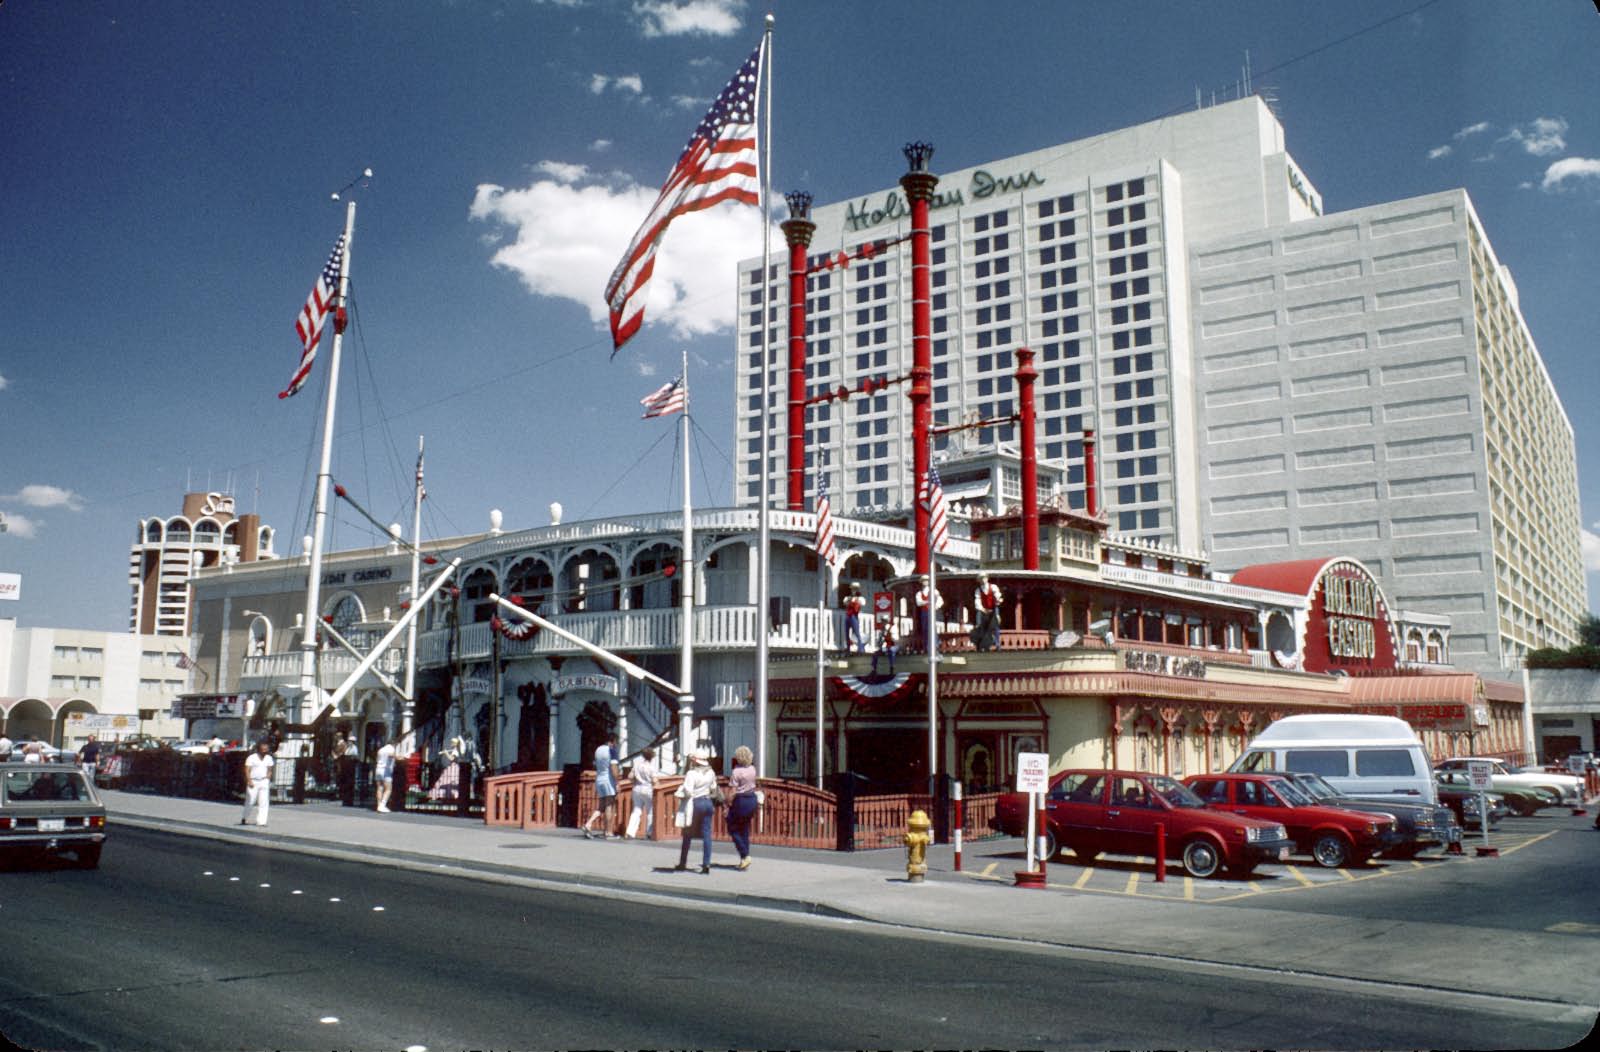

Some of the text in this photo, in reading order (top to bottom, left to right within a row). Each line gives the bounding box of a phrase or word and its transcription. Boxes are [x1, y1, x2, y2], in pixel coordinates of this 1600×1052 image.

[846, 170, 1046, 231] Holiay Inn
[353, 567, 392, 582] CASINO
[1323, 575, 1378, 619] HOLIDAY
[1329, 617, 1375, 659] CASINO
[559, 674, 607, 689] CASINO
[1027, 760, 1040, 768] NO
